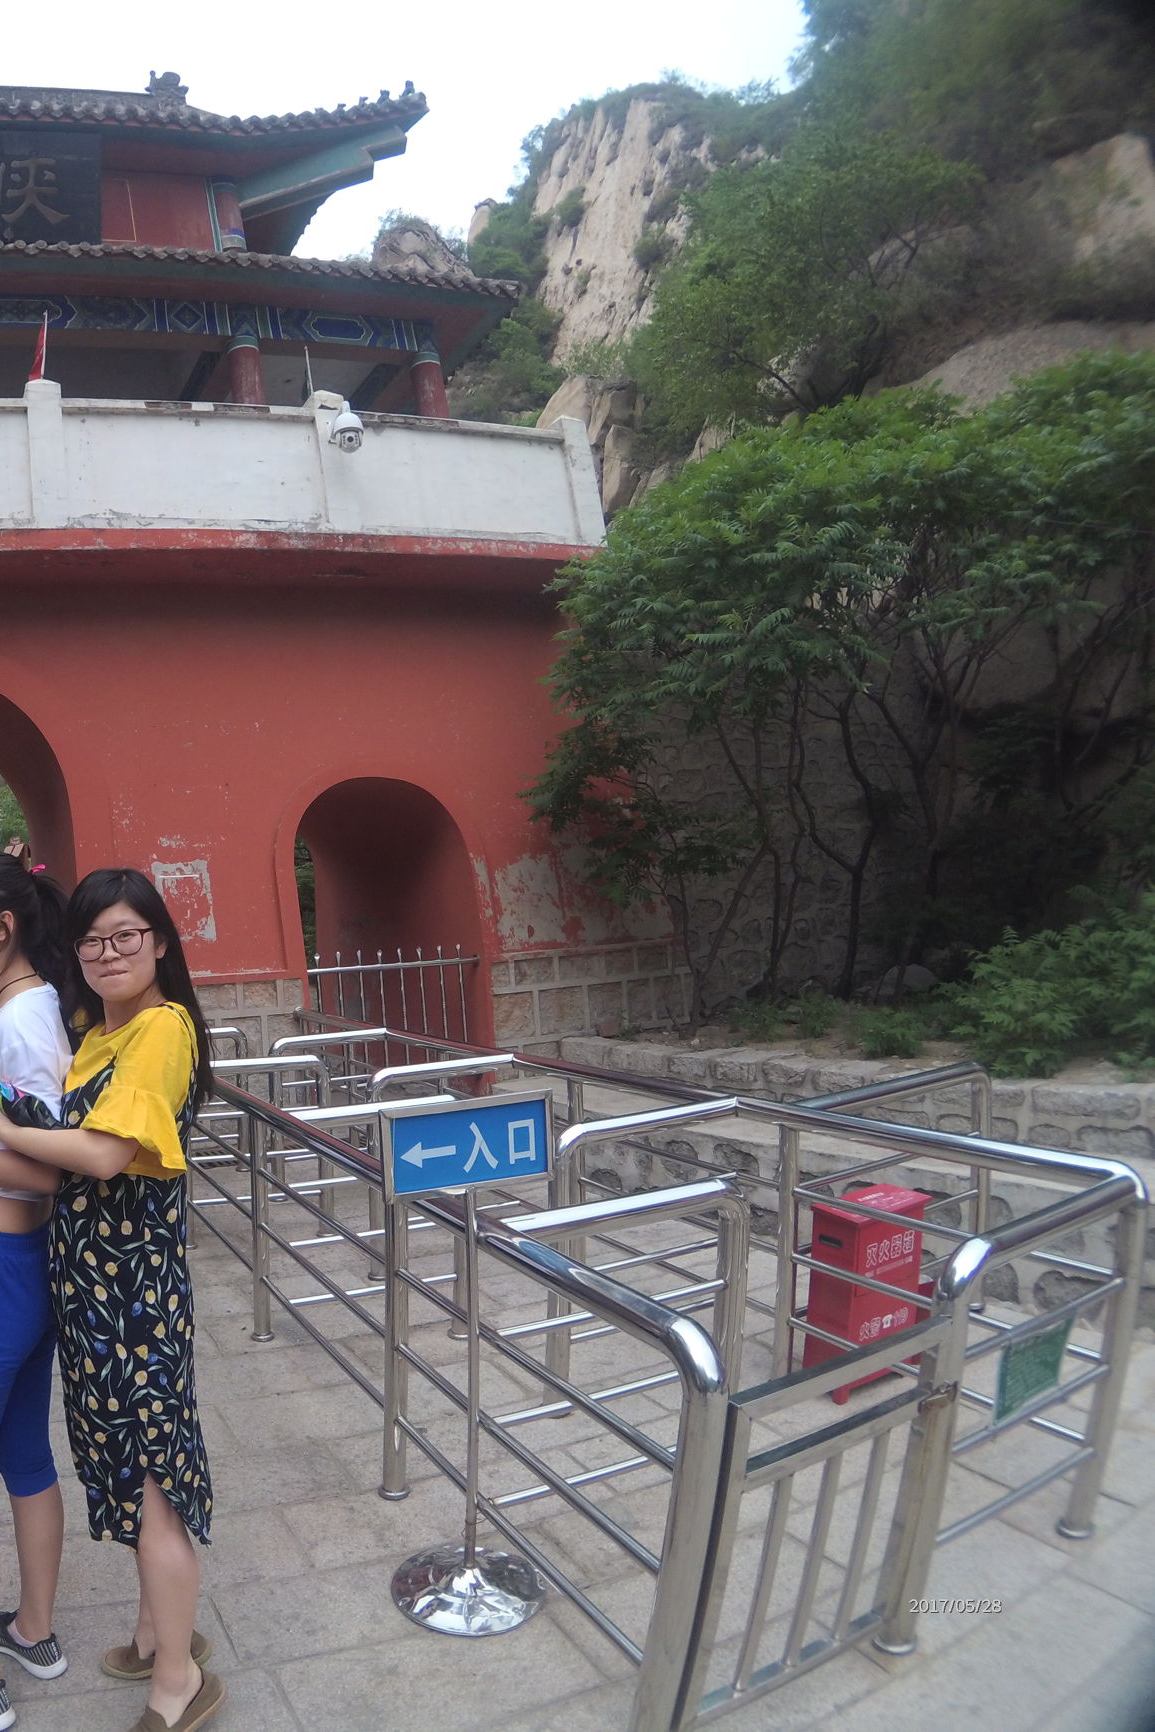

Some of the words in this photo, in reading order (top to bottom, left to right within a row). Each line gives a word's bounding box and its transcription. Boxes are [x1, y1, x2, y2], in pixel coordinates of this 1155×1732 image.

[463, 1118, 536, 1173] 入口
[866, 1229, 915, 1268] 灭火器箱
